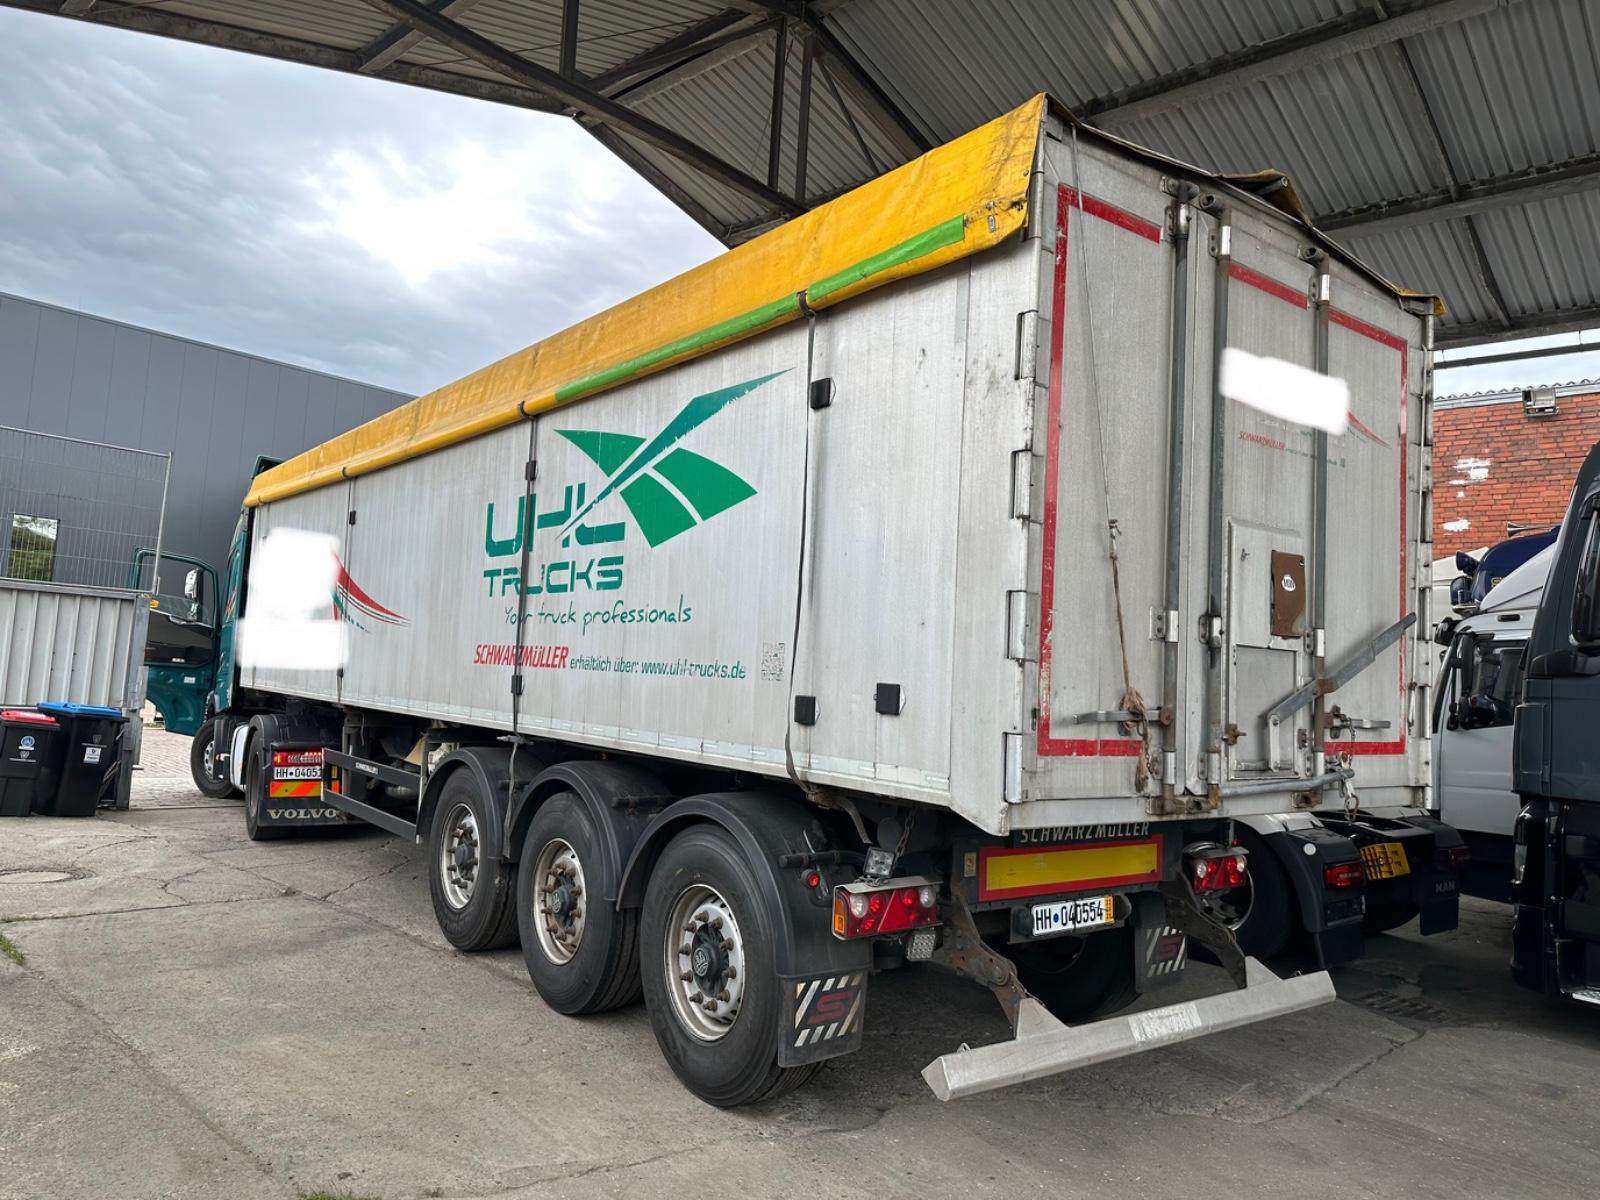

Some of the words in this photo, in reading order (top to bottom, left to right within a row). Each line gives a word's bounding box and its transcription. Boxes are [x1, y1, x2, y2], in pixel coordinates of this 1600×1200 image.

[485, 481, 626, 558] UHL
[483, 555, 624, 598] TRUCKS
[538, 600, 576, 625] truck
[583, 593, 692, 637] professionals
[474, 644, 569, 669] SCHWARZMÜLLER
[570, 655, 612, 673] erhältlich
[613, 657, 639, 674] über:
[641, 658, 747, 679] www.uhl-trucks.de
[276, 768, 288, 778] HH
[267, 808, 337, 820] VOLVO
[1035, 908, 1052, 931] HH
[1061, 900, 1103, 927] 040554
